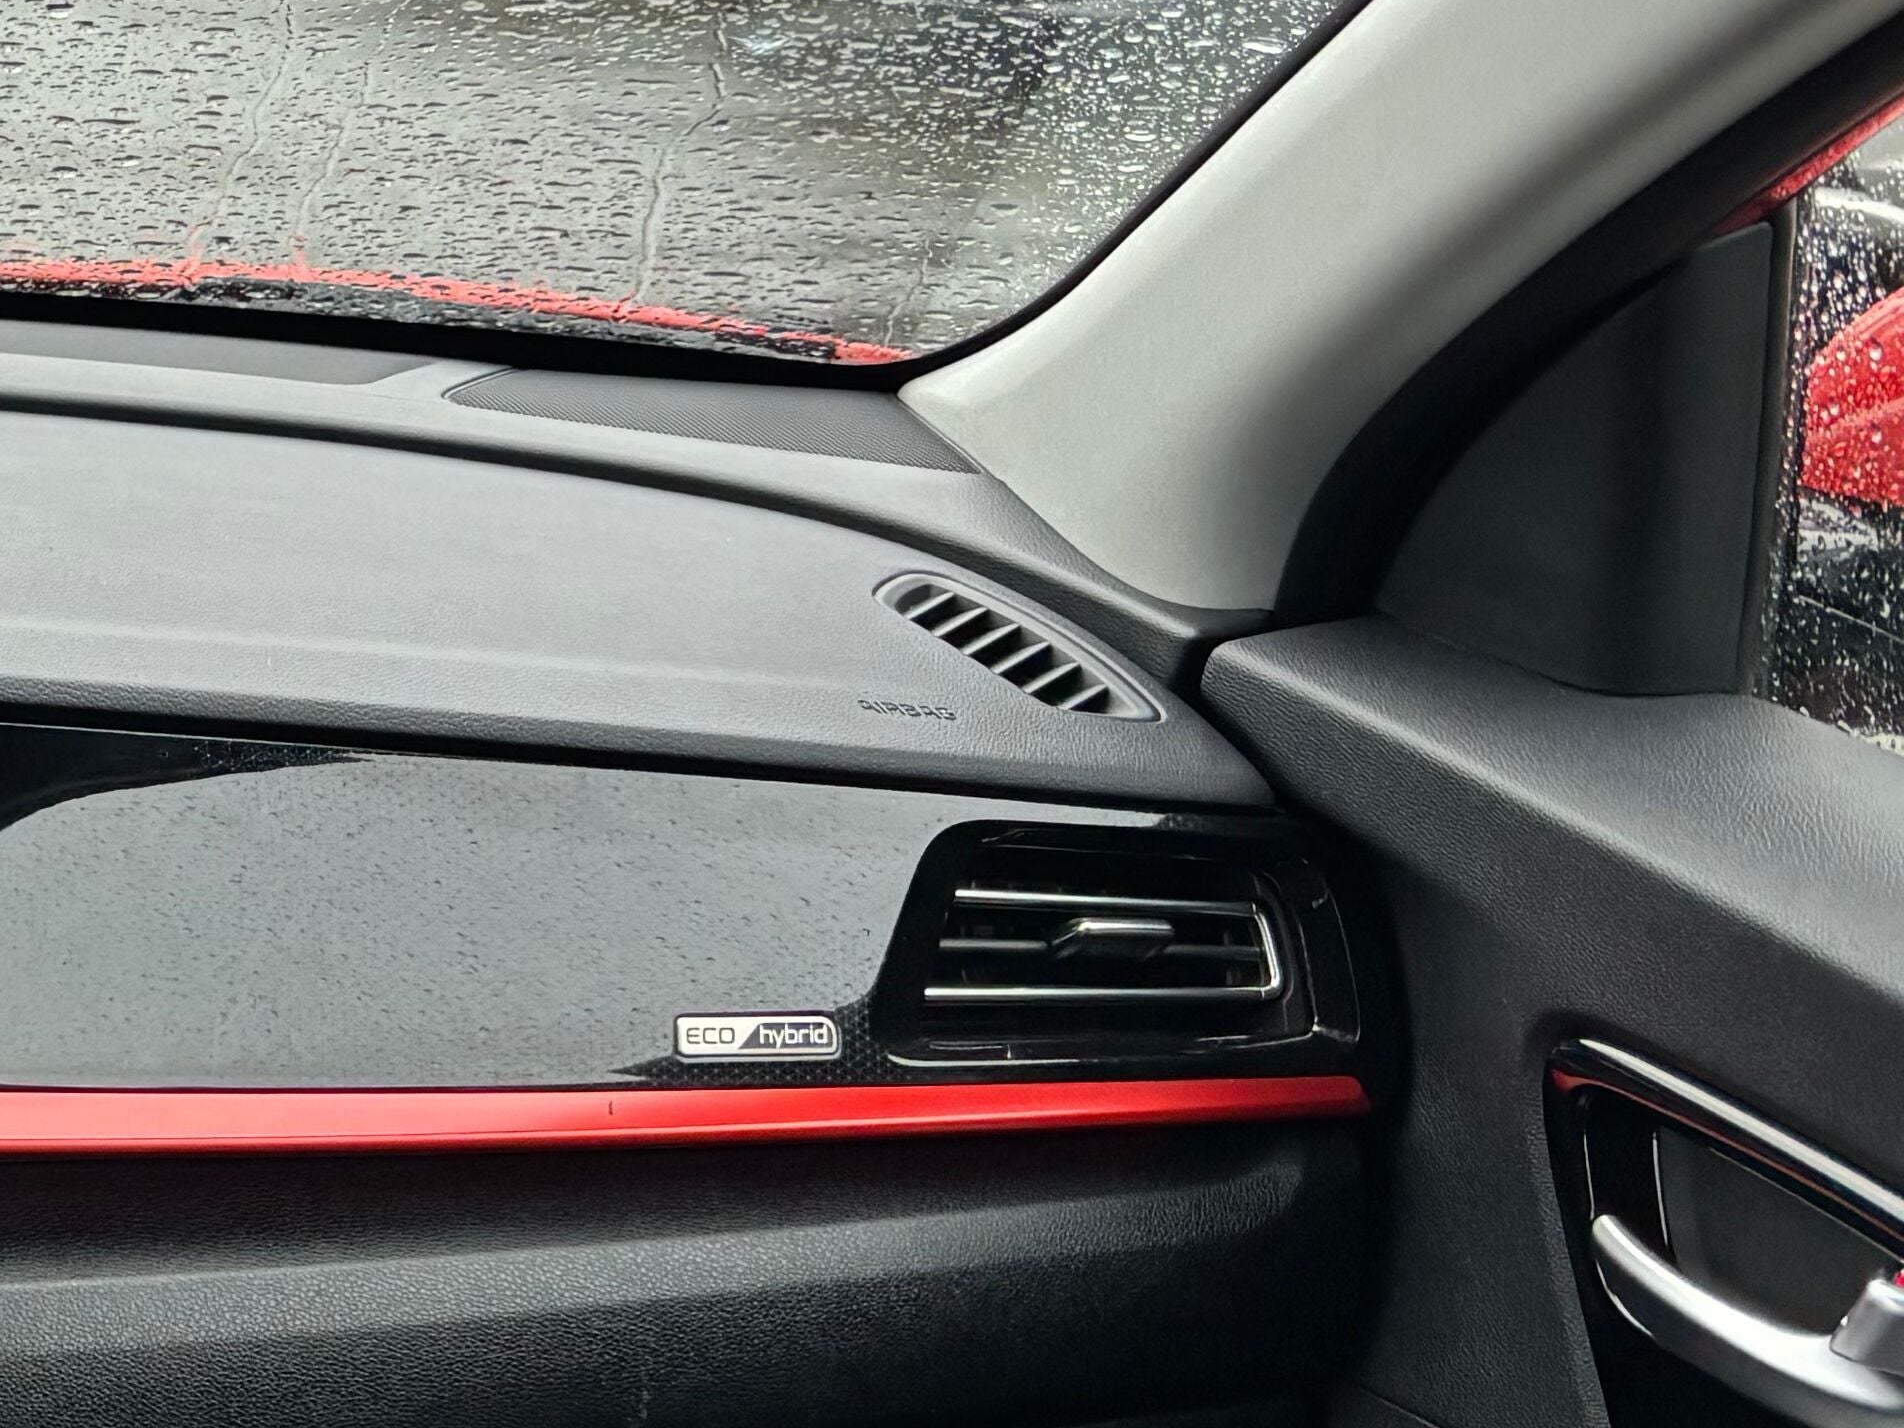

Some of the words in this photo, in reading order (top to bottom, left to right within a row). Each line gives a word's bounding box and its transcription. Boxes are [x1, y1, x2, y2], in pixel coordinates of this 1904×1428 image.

[856, 698, 956, 721] AIRBAG
[685, 1026, 736, 1046] ECO
[758, 1022, 829, 1050] hybrid
